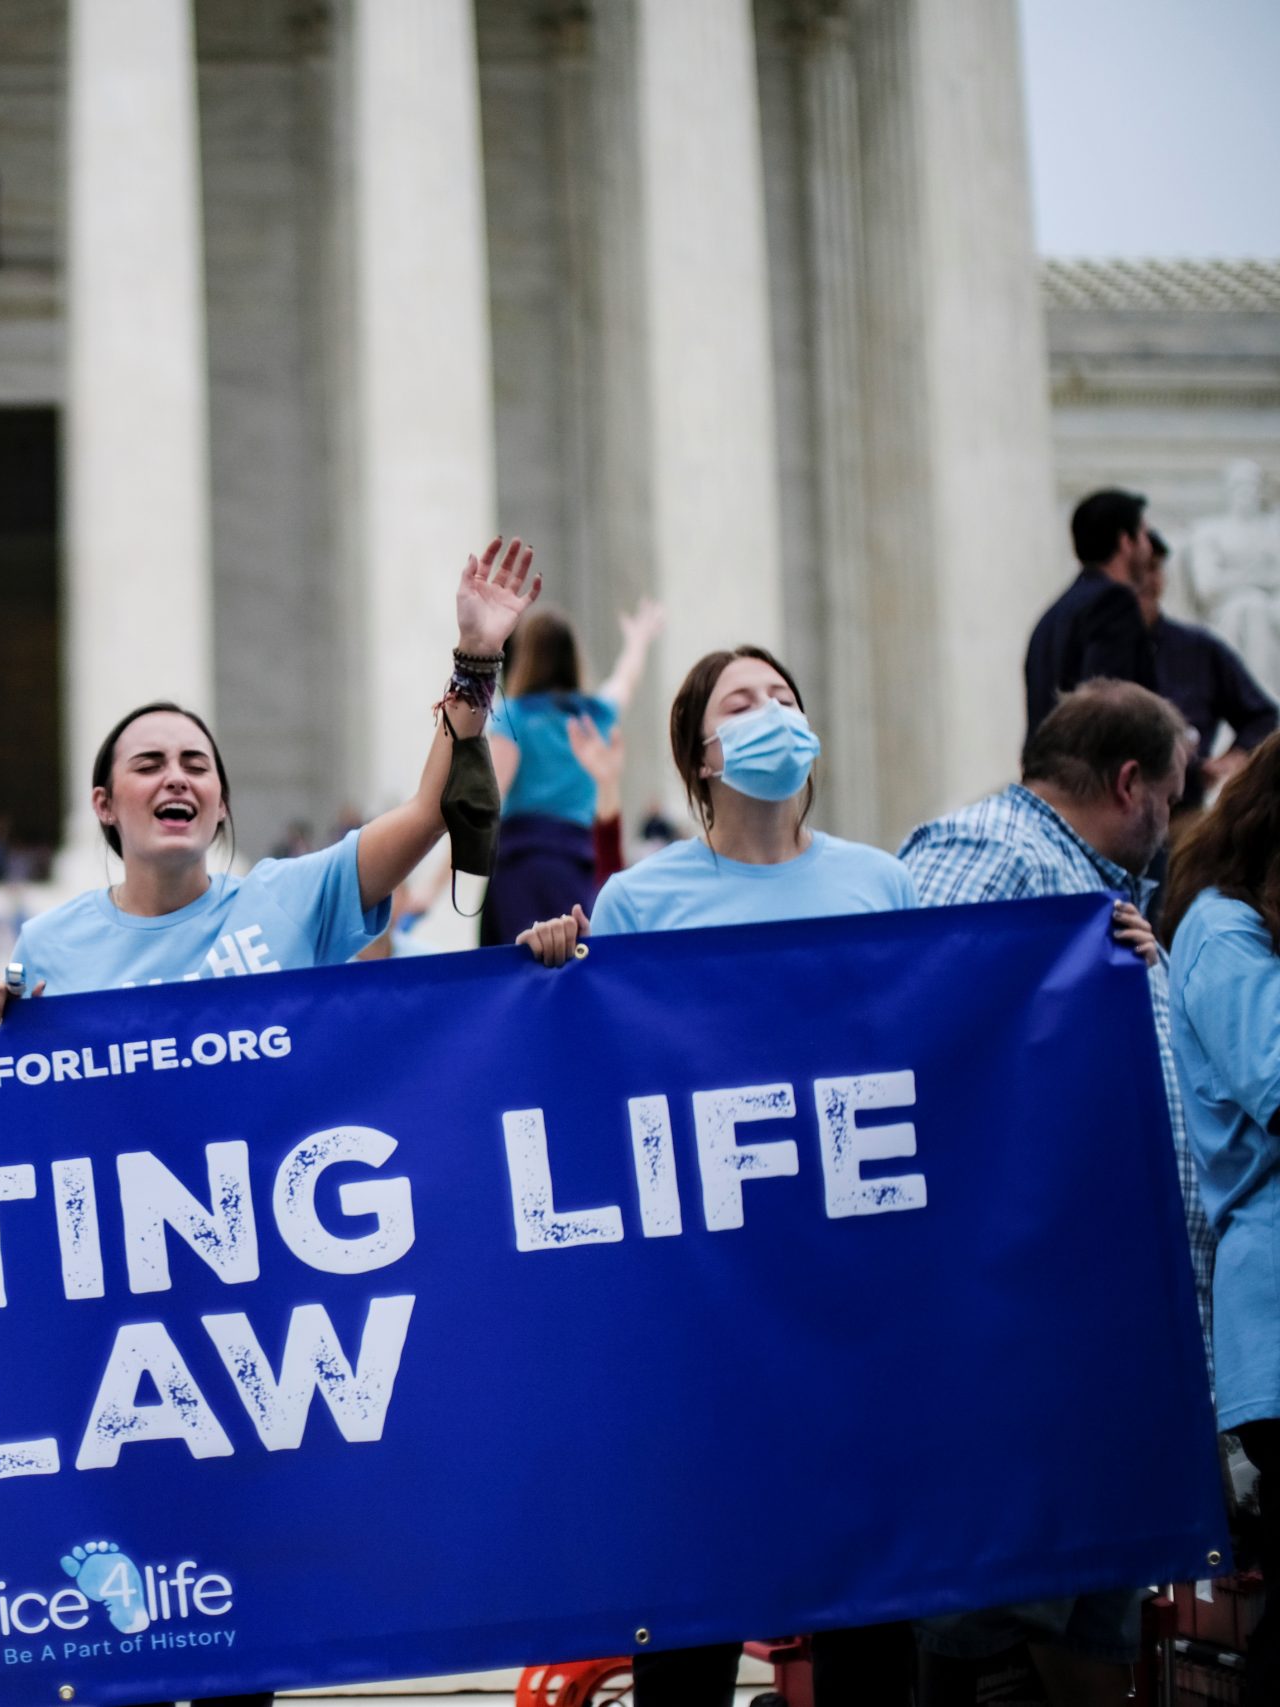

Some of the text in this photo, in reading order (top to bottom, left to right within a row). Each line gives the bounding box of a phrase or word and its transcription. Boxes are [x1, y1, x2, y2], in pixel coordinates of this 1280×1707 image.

[183, 924, 281, 982] HE
[502, 1069, 927, 1252] LIFE
[4, 1630, 236, 1665] Be A Part of History
